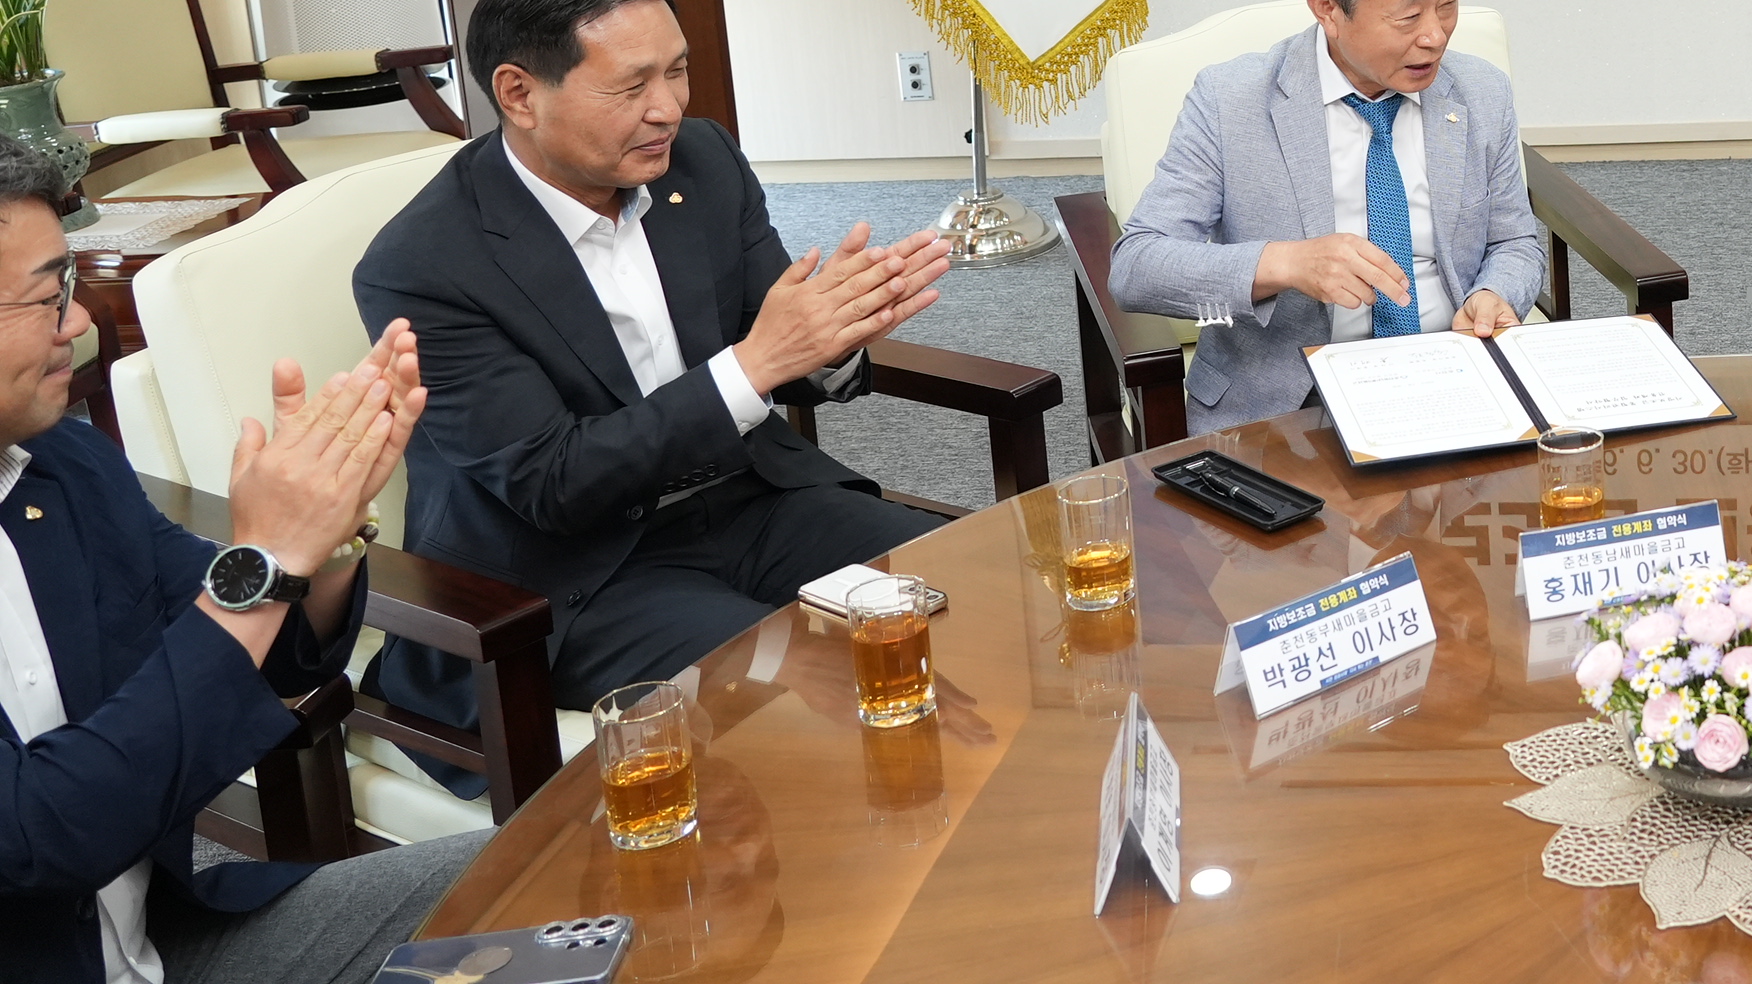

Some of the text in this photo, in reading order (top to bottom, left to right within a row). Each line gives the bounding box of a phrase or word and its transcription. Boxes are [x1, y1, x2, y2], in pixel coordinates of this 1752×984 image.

[1554, 513, 1688, 547] 지방보조금 전용계좌 협약식
[1563, 536, 1686, 569] 춘천동남새마을금고
[1266, 573, 1389, 632] 지방보조금 전용계좌 협약식
[1543, 566, 1620, 603] 홍재기
[1262, 641, 1339, 689] 박광선
[1352, 607, 1420, 655] 이사장
[1279, 598, 1393, 655] 춘천동부새마을금고
